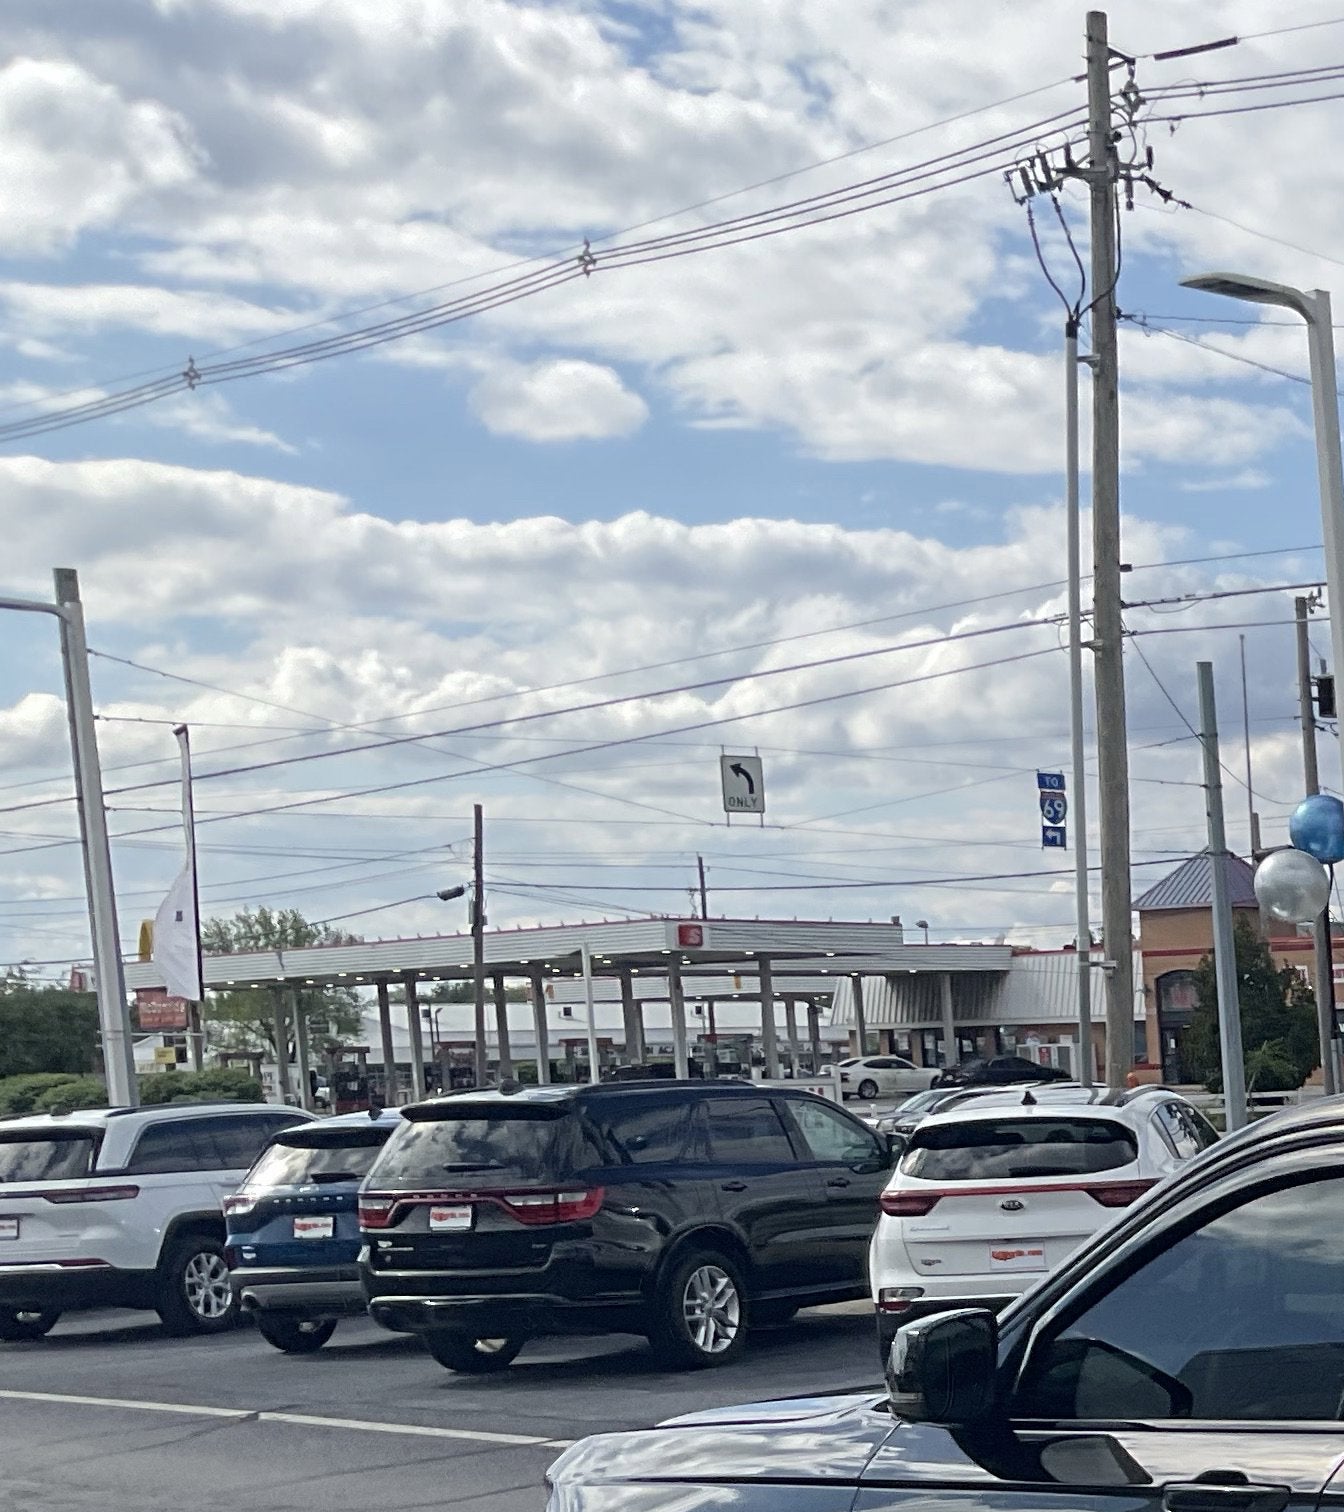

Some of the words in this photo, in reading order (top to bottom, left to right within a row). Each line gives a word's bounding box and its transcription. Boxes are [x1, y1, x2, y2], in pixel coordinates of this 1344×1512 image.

[1045, 776, 1059, 788] TO
[728, 796, 757, 808] ONLY
[1044, 799, 1064, 818] 69
